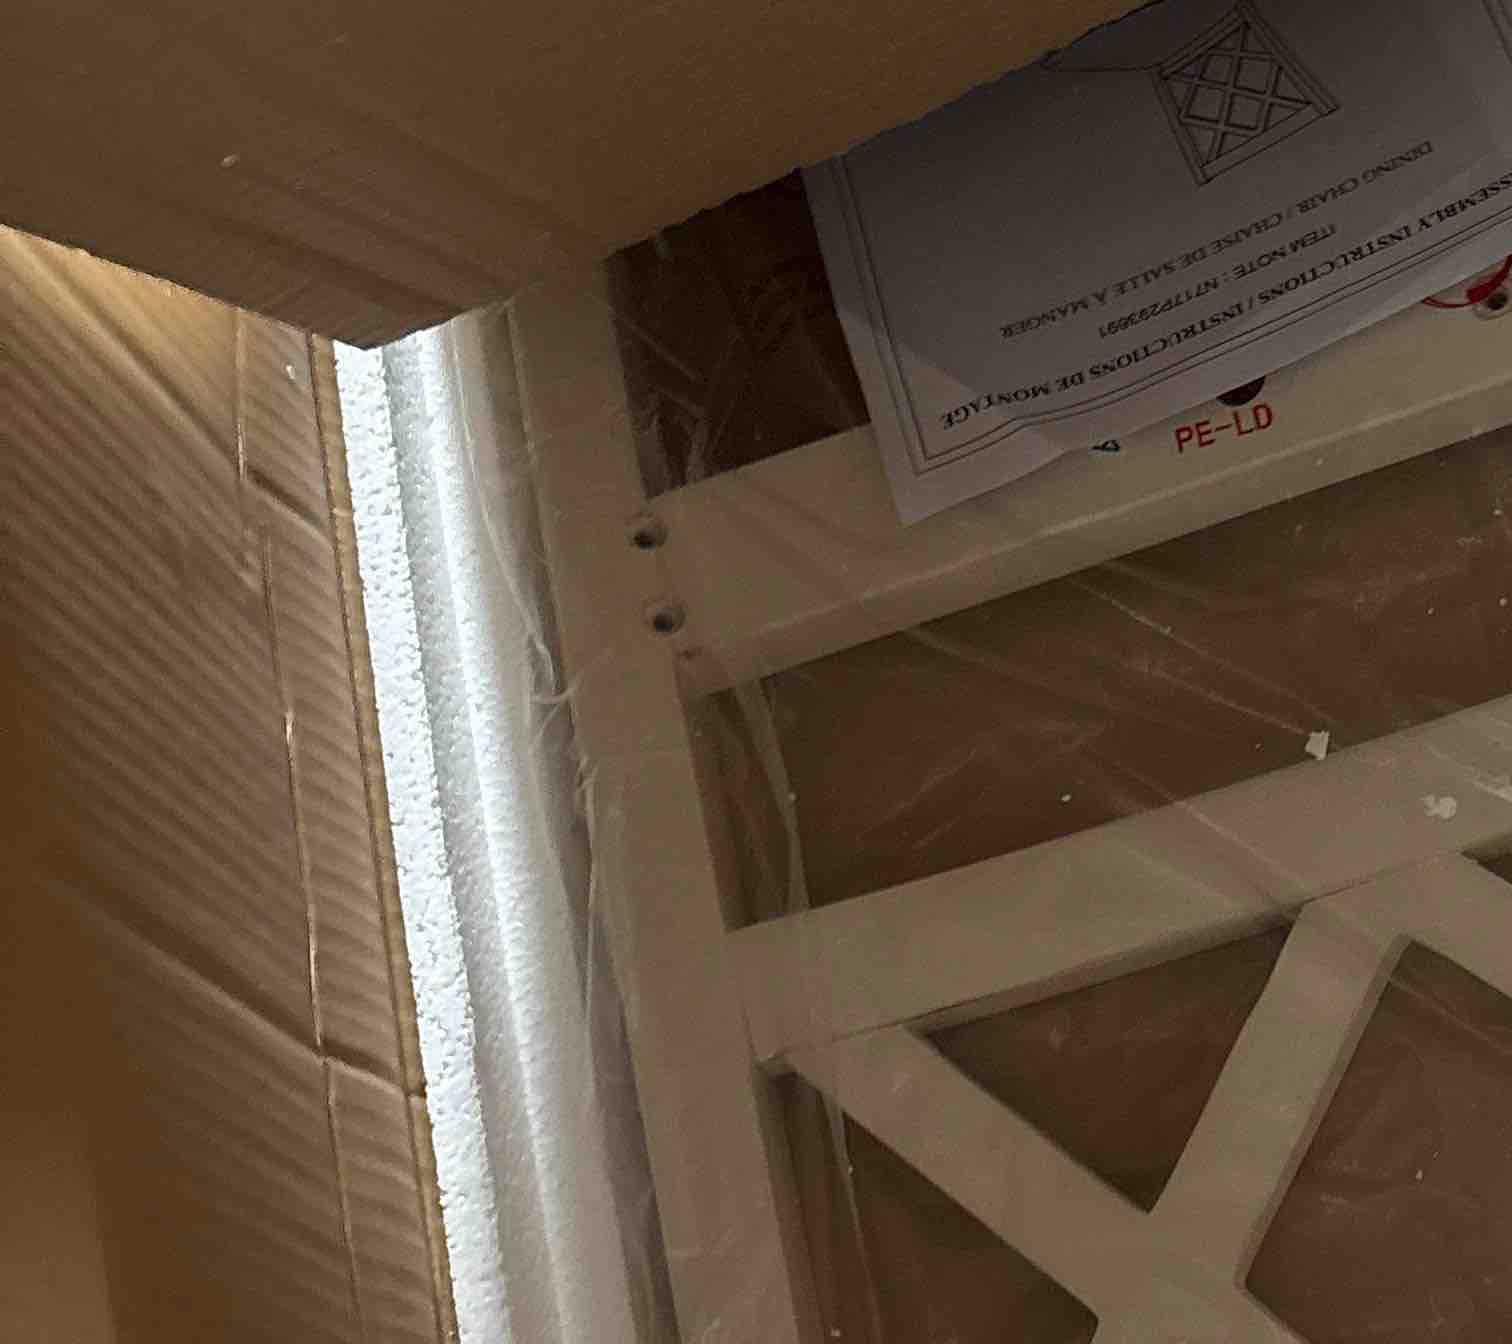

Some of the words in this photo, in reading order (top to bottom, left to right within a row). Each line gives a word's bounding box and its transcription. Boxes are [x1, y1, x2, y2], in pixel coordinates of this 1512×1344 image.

[1361, 140, 1434, 184] DINING
[1296, 177, 1359, 214] CHAIR
[1210, 212, 1283, 256] CHAISE
[1289, 223, 1337, 249] ITEM
[1180, 247, 1208, 267] DE
[1232, 243, 1286, 279] NOTE
[1259, 227, 1412, 304] INSTRUCTIONS
[1113, 263, 1177, 294] SALLE
[999, 299, 1090, 340] MANGER
[1089, 303, 1244, 380] INSTRUCTIONS
[1056, 372, 1084, 392] DE
[942, 382, 1051, 430] MONTAGE
[1173, 403, 1274, 454] PE-LD
